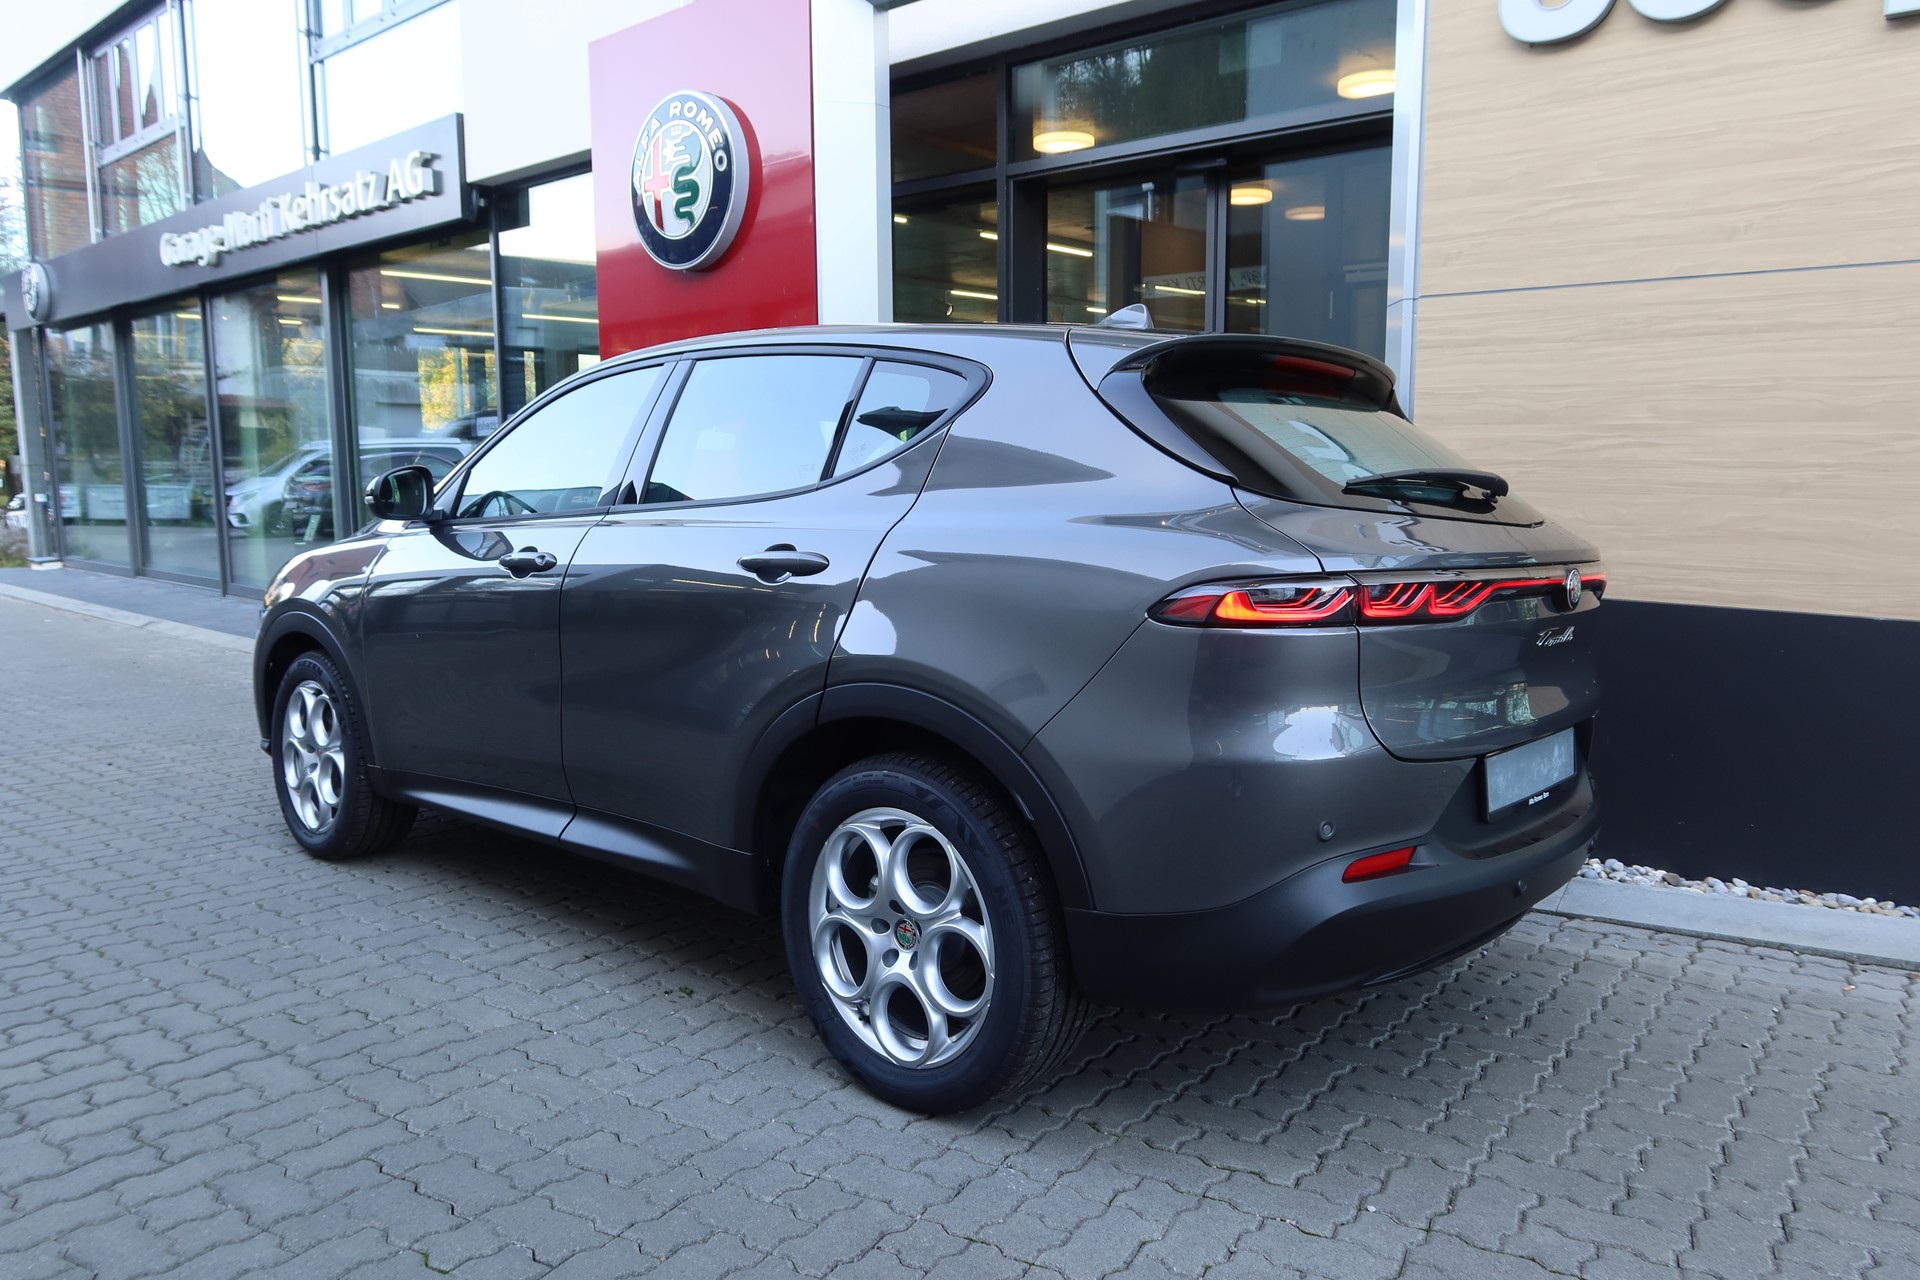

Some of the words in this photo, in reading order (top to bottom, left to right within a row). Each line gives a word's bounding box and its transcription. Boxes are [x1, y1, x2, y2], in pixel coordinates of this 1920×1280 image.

[633, 117, 661, 190] ALFA
[669, 101, 727, 171] ROMEO
[279, 170, 388, 231] Kehrsatz
[386, 150, 434, 202] AG
